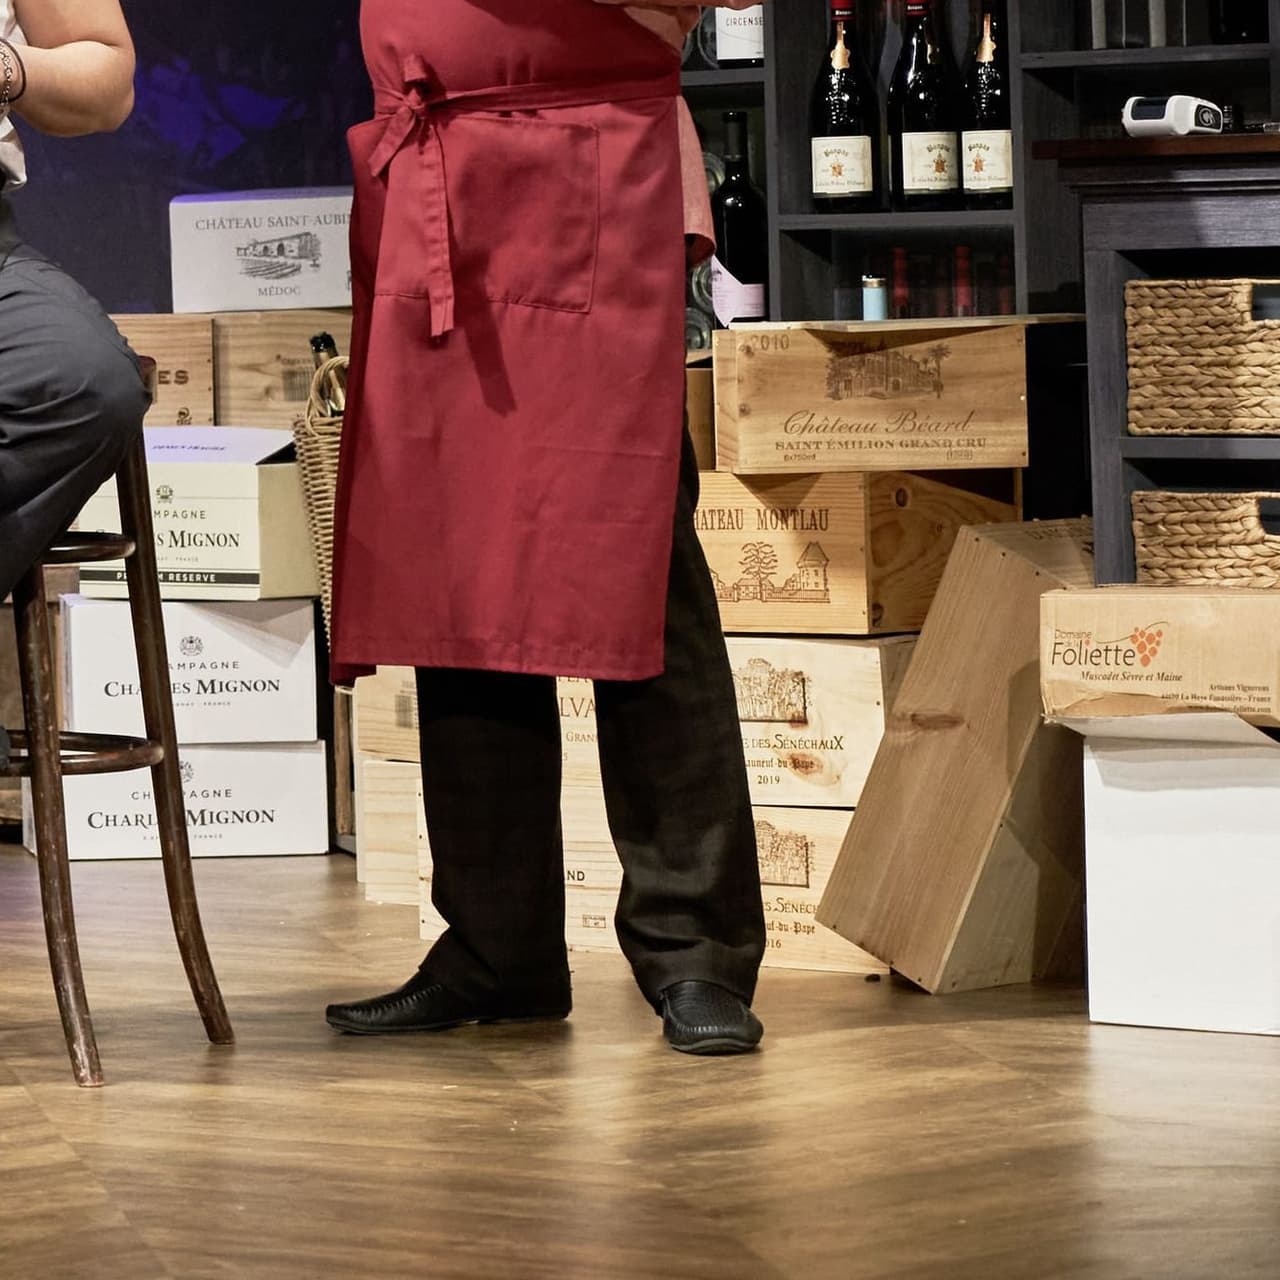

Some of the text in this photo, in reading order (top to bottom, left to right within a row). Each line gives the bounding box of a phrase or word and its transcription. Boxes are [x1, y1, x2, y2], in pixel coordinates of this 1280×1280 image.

[195, 216, 263, 230] CHÂTEAU
[258, 285, 301, 297] MÉDOC
[752, 334, 790, 351] 2010
[158, 370, 189, 385] ES
[784, 409, 877, 436] Château
[775, 440, 822, 451] SAINT
[899, 438, 954, 449] GRAND
[957, 437, 987, 448] CRU
[154, 510, 207, 520] MPAGNE
[756, 508, 830, 532] MONTLAU
[167, 530, 240, 548] MIGNON
[168, 572, 216, 583] RESERVE
[1051, 639, 1136, 666] Foliette
[1080, 671, 1183, 682] Muscadet Sèvre et Maine
[104, 679, 280, 697] CHES MIGNON
[566, 731, 598, 743] GRAN
[752, 738, 771, 749] DES
[757, 775, 781, 785] 2019
[131, 789, 233, 800] CHAGNE
[88, 809, 276, 830] CHARL MIGNON
[567, 870, 585, 881] ND
